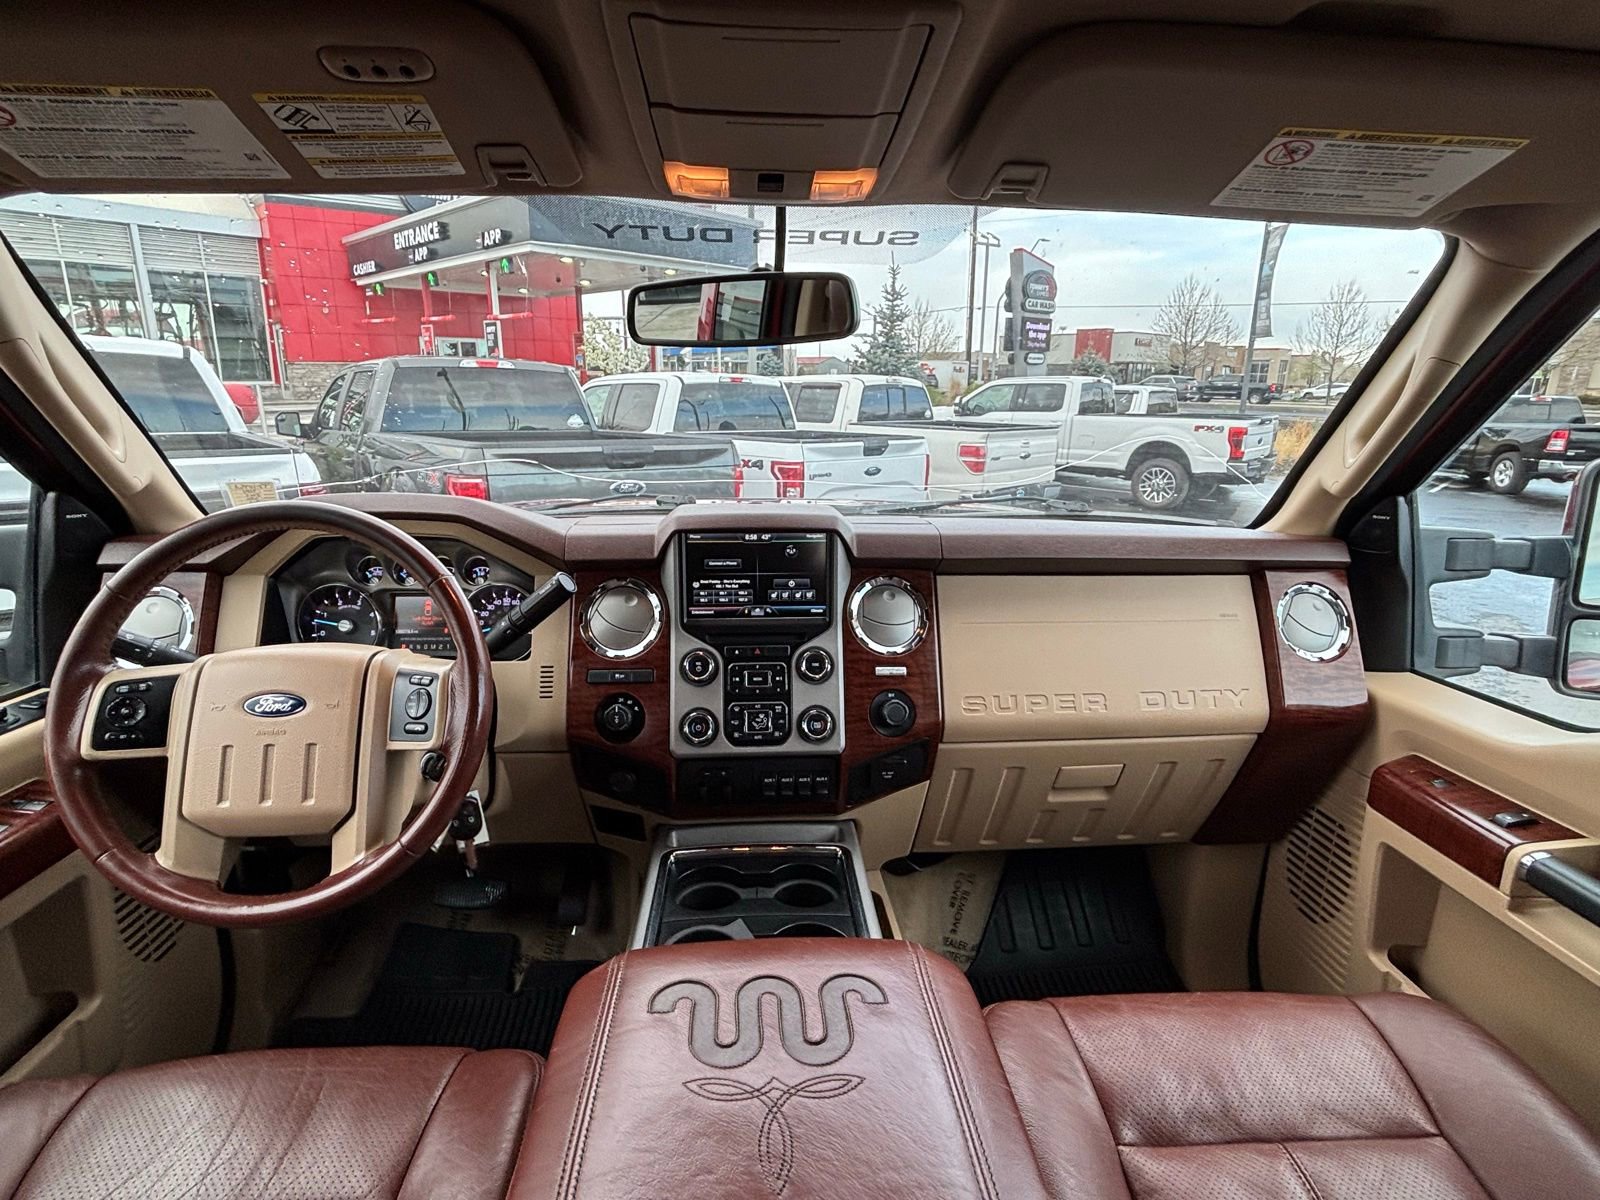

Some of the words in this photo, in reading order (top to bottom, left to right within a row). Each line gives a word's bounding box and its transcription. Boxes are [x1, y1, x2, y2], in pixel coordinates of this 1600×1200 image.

[393, 221, 440, 250] ENTRANCE
[483, 228, 501, 247] APP
[414, 247, 428, 262] APP
[353, 260, 376, 276] CASHIER
[1027, 299, 1039, 308] CAR
[1039, 300, 1055, 310] WASH
[1025, 321, 1050, 331] Download
[1193, 425, 1225, 434] FX4
[254, 696, 297, 712] Ford
[961, 691, 1108, 716] SUPER
[1138, 688, 1249, 712] DUTY
